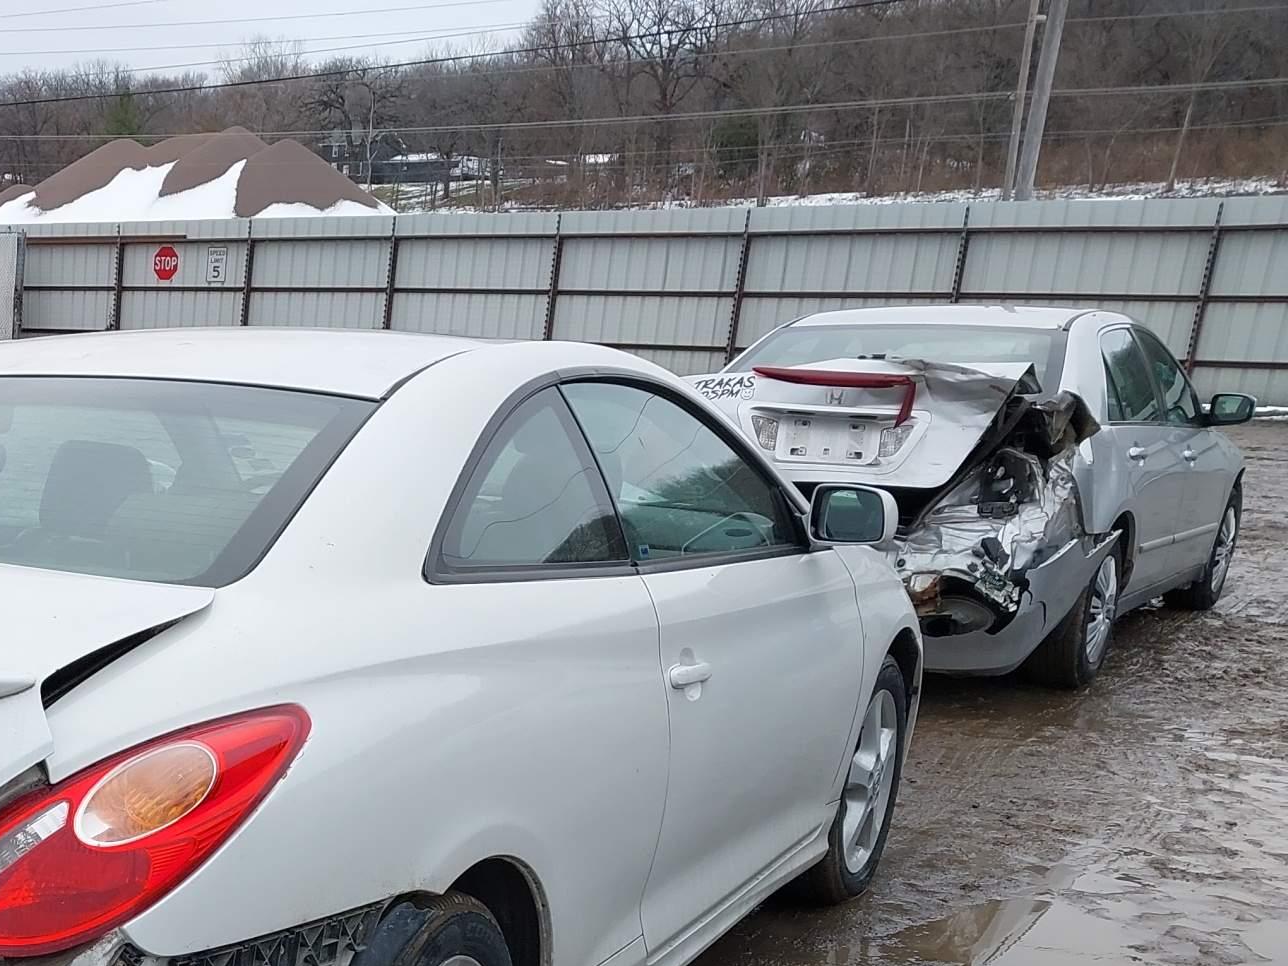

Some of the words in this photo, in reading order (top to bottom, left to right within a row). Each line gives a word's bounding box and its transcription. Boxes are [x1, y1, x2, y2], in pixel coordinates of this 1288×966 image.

[155, 256, 178, 270] STOP
[212, 265, 221, 279] 5
[694, 376, 756, 391] TRAKAS
